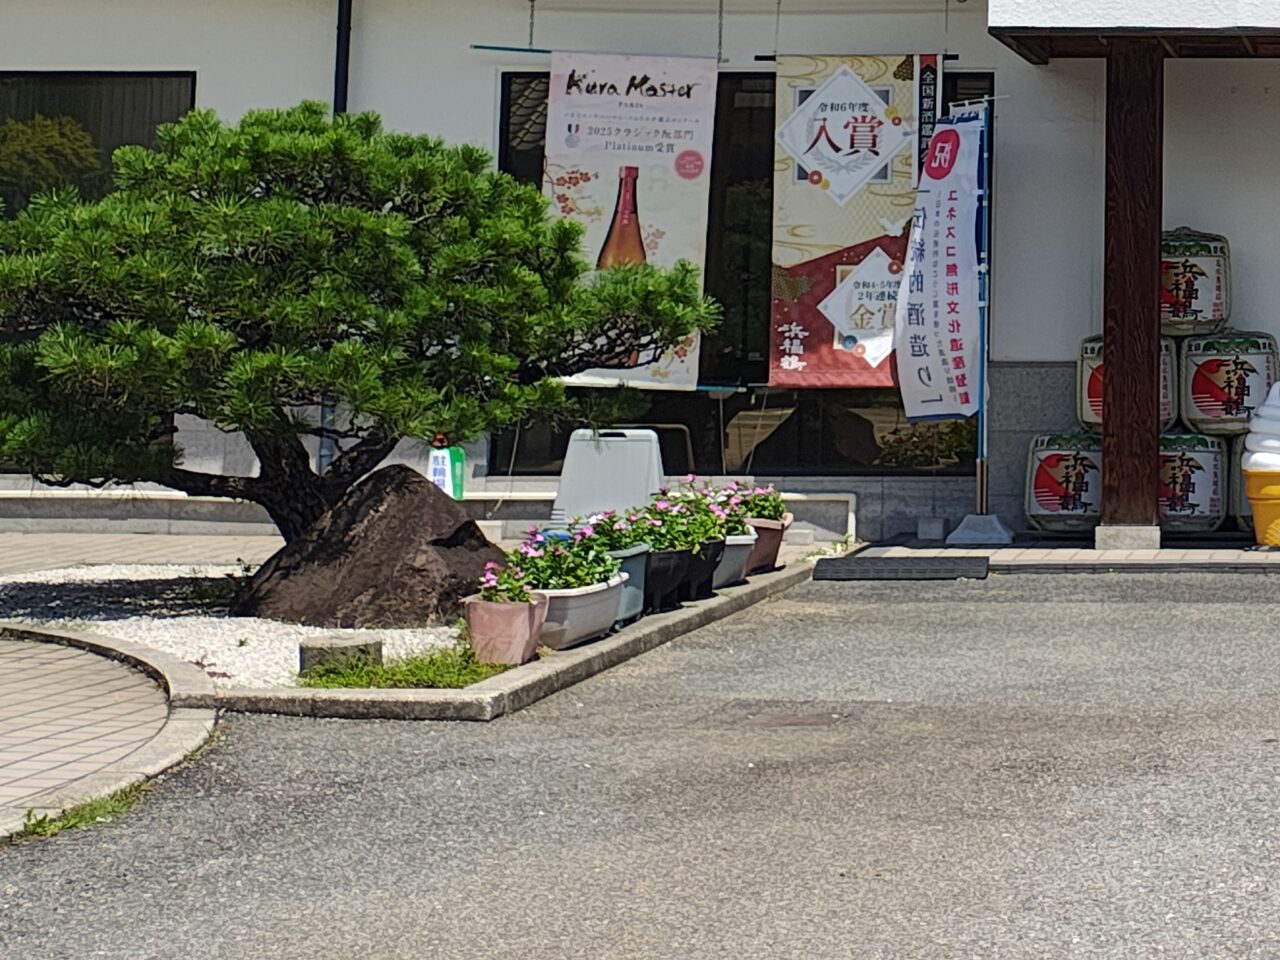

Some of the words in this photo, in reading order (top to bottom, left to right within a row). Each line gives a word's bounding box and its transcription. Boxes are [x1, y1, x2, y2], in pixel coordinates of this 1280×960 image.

[565, 69, 621, 97] Kura
[625, 73, 702, 99] Master
[819, 102, 870, 113] 令和6年度
[803, 115, 885, 157] 入賞
